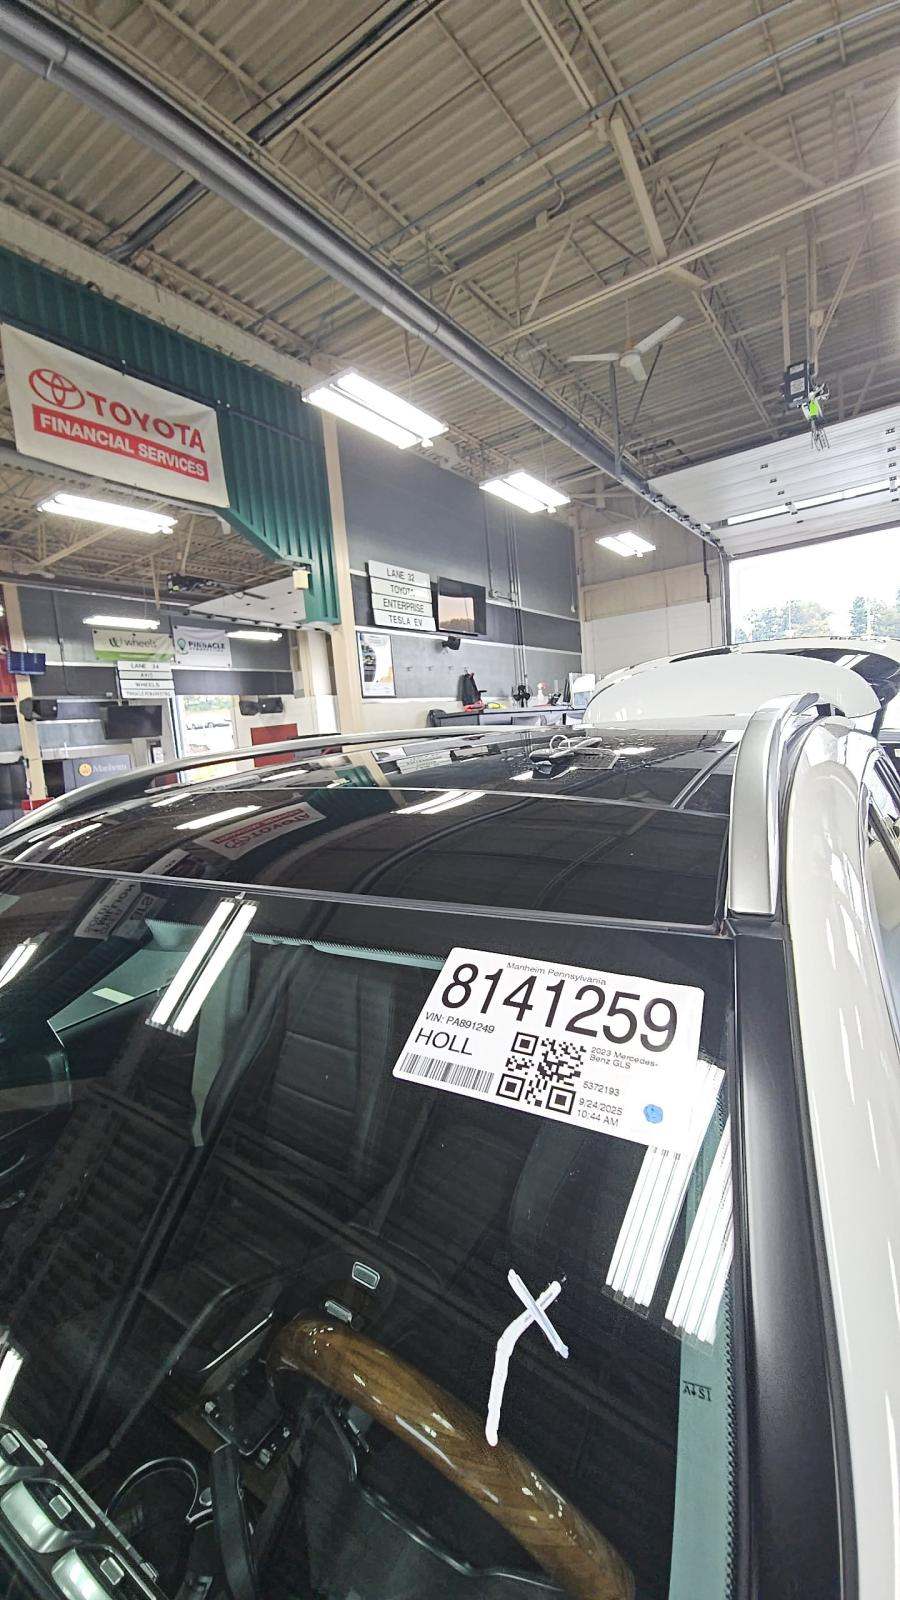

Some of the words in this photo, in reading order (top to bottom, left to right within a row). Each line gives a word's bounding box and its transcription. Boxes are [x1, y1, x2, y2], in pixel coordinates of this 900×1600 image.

[86, 391, 206, 453] TOYOTA
[40, 413, 136, 454] FINANCIAL
[138, 443, 205, 477] SERVICES
[386, 567, 405, 580] LANE
[383, 598, 424, 613] ENTERPRISE
[389, 614, 411, 625] TESLA
[413, 618, 424, 627] EV
[188, 640, 226, 650] PINNACLE
[505, 962, 546, 975] Manheim
[547, 969, 607, 986] Pennsylvania
[441, 963, 678, 1052] 8141259
[425, 1011, 445, 1024] VIN:
[446, 1016, 496, 1034] PA891249
[415, 1027, 473, 1056] HOLL
[589, 1054, 611, 1065] Benz
[612, 1059, 631, 1070] GLS
[590, 1046, 612, 1057] 2023
[614, 1051, 659, 1067] Mercedes-
[582, 1080, 620, 1097] 5372193
[578, 1097, 623, 1116] 9/24/2025
[577, 1109, 601, 1122] 10:44
[603, 1114, 619, 1127] AM
